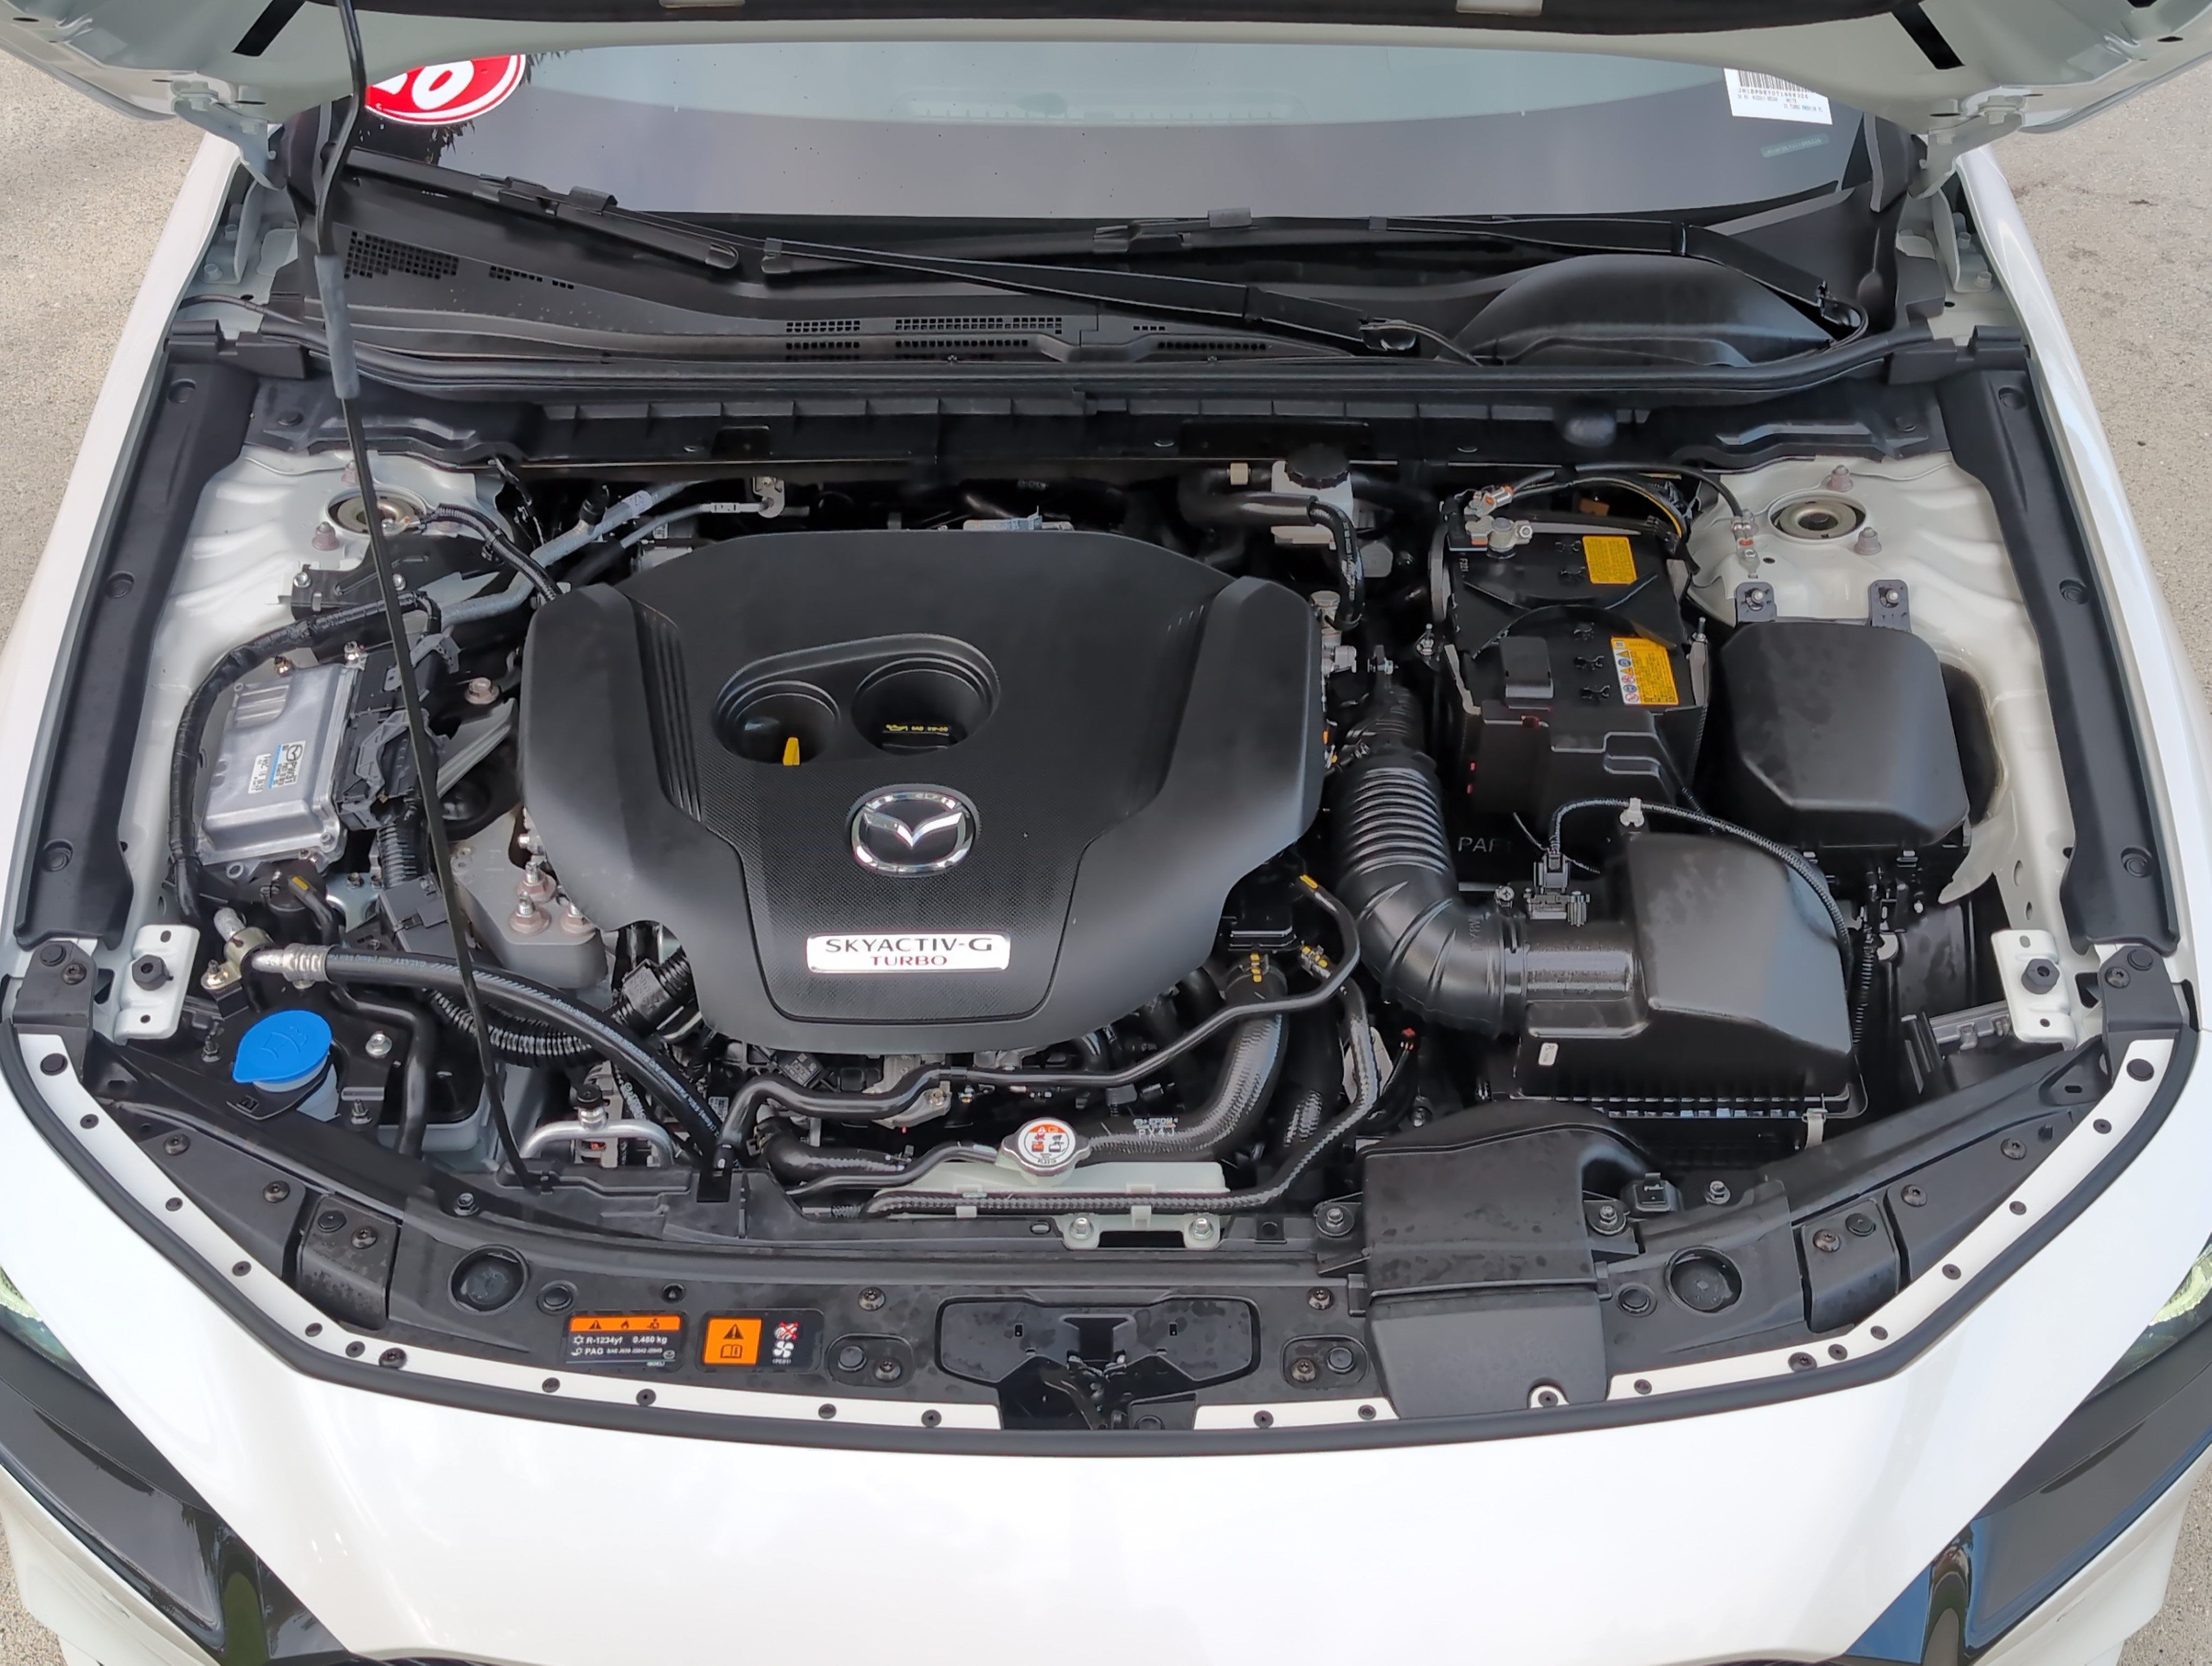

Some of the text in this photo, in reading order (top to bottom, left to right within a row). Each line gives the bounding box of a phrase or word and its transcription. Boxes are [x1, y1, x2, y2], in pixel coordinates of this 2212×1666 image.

[825, 937, 992, 953] SKYACTIV-G
[870, 955, 947, 966] TURBO
[586, 1336, 623, 1345] R-1234yf
[657, 1335, 667, 1344] kg
